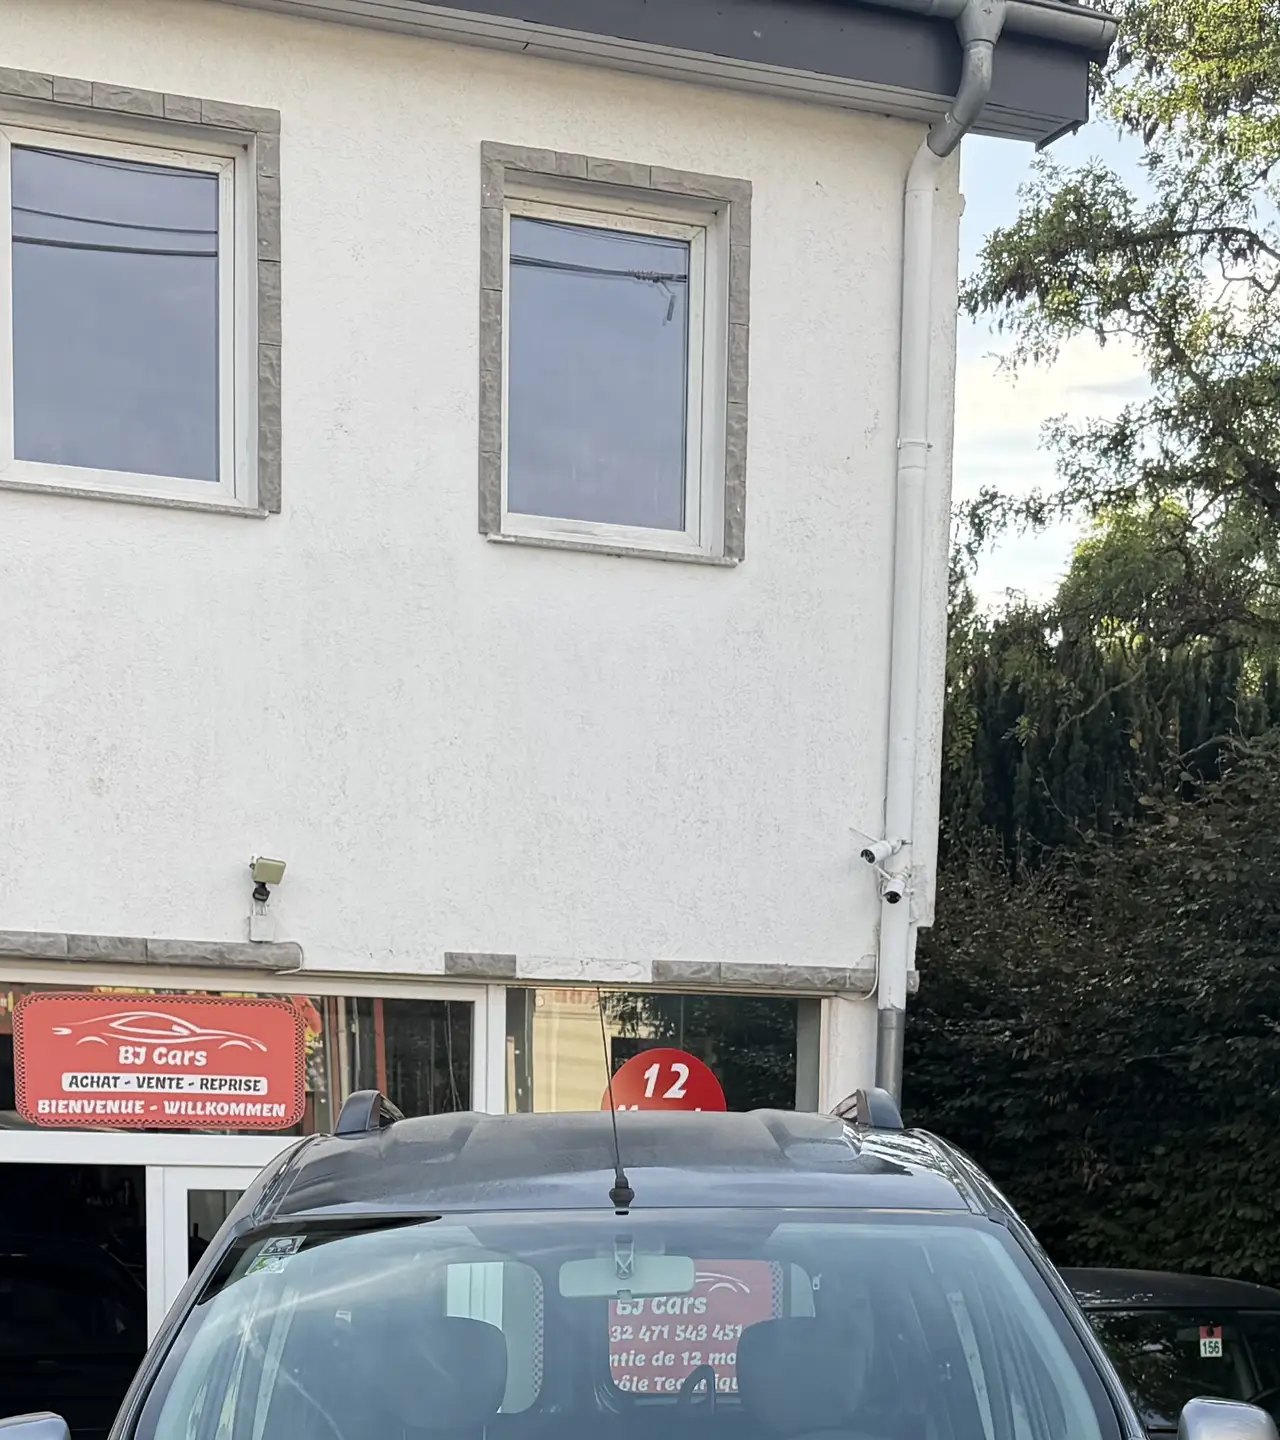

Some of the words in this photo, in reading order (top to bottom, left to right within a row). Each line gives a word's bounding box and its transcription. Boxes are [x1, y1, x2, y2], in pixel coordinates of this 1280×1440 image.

[118, 1045, 147, 1065] BJ
[152, 1047, 207, 1067] Cars
[68, 1075, 121, 1089] ACHAT
[136, 1076, 184, 1090] VENTE
[199, 1077, 261, 1092] REPRISE
[643, 1062, 691, 1099] 12
[37, 1099, 145, 1115] BIENVENUE
[163, 1100, 286, 1117] WILLKOMMEN
[651, 1296, 707, 1315] Cars
[638, 1324, 670, 1342] 471
[675, 1324, 708, 1341] 543
[1203, 1341, 1220, 1355] 156
[651, 1350, 675, 1366] de
[681, 1351, 702, 1366] 12
[708, 1352, 737, 1366] mo
